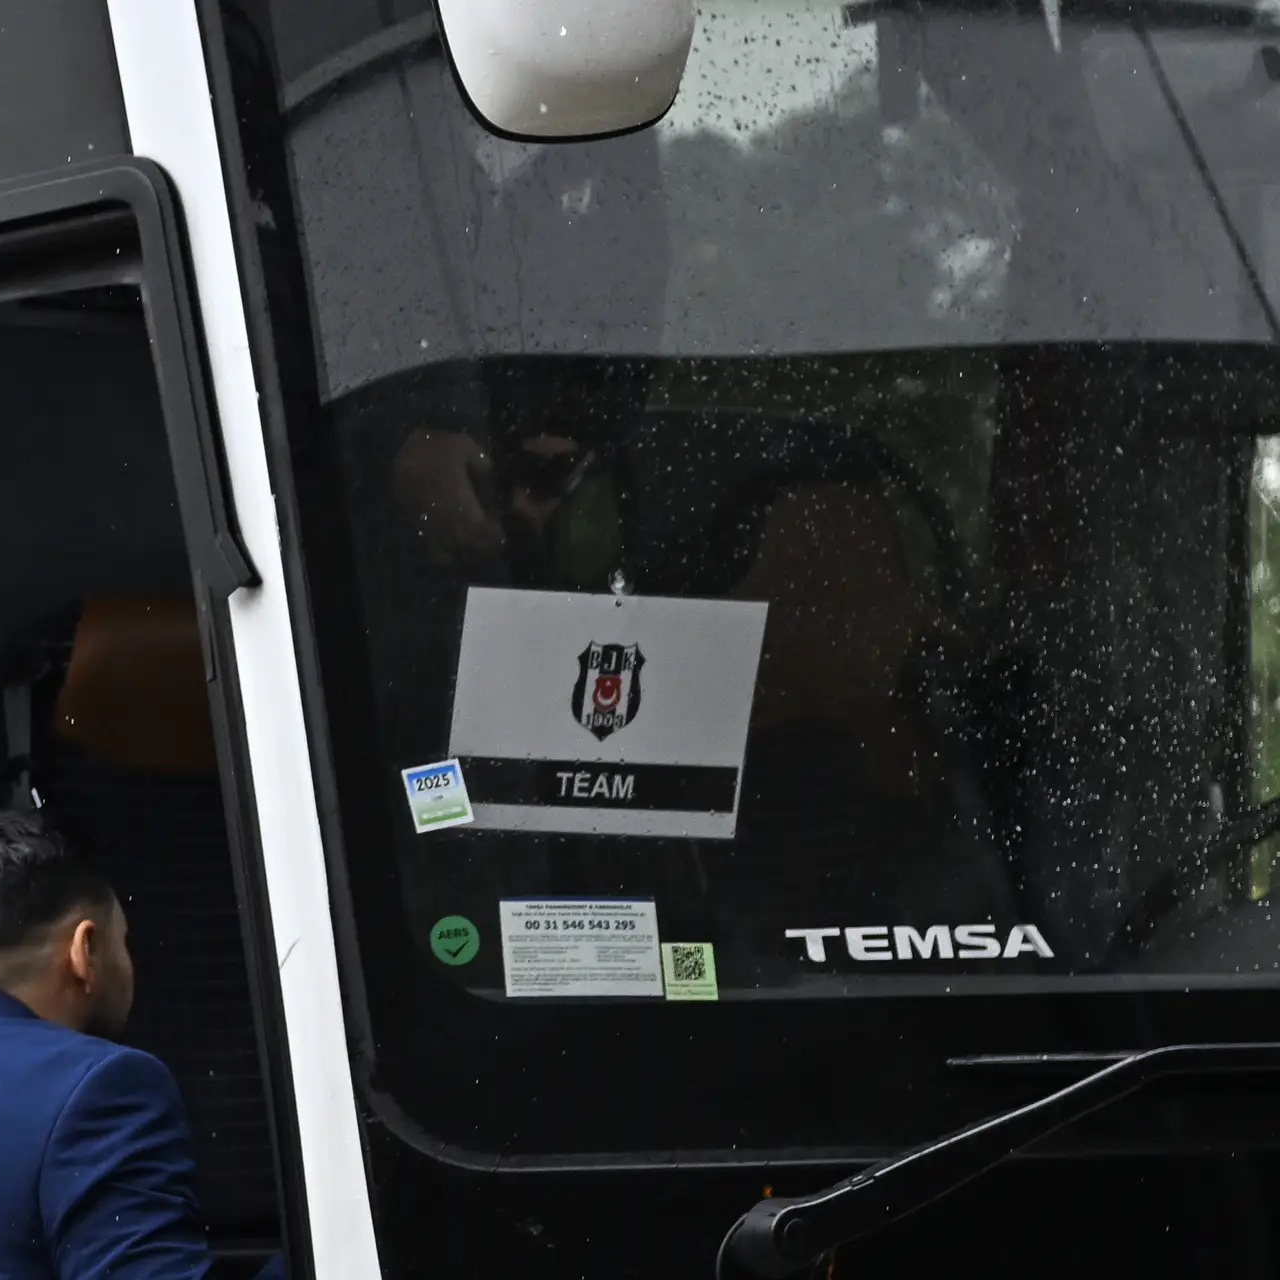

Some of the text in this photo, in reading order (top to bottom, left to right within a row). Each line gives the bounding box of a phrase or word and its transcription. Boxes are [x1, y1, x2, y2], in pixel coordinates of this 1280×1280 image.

[589, 650, 635, 671] BJK
[585, 713, 625, 729] 1903
[416, 774, 450, 792] 2025
[556, 770, 635, 799] TEAM
[525, 920, 636, 930] 00 31 546 543 295
[785, 924, 1055, 962] TEMSA
